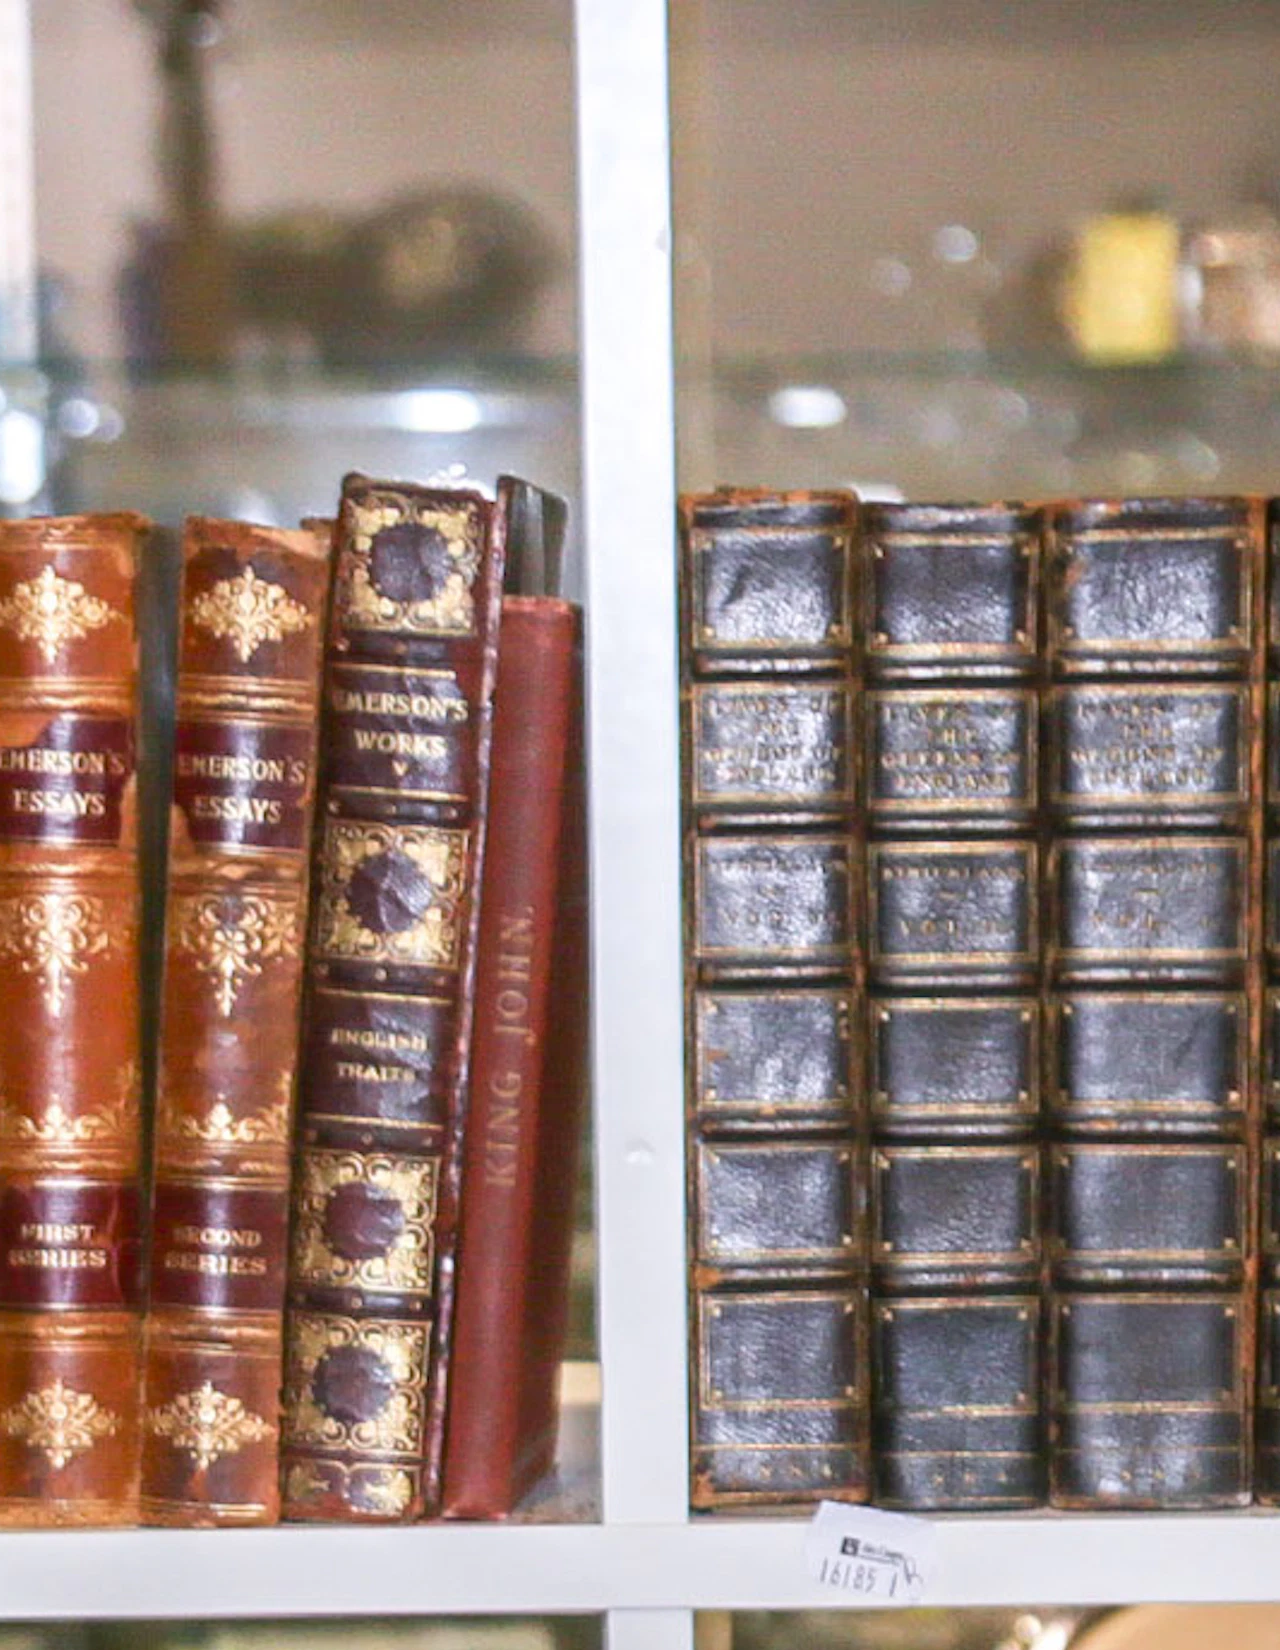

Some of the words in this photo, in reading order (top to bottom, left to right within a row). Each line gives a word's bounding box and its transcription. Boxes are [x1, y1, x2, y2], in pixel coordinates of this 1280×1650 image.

[331, 689, 470, 722] EMERSON'S
[352, 729, 449, 759] WORKS
[179, 754, 307, 784] EMERSON'S
[14, 789, 107, 816] ESSAYS
[194, 796, 282, 824] ESSAYS
[331, 1027, 428, 1052] ENGLISH
[337, 1061, 417, 1084] TRAITS
[485, 1070, 523, 1187] KING
[21, 1224, 95, 1244] FIRST
[173, 1226, 263, 1248] SECOND
[8, 1248, 107, 1269] SERIES
[164, 1253, 268, 1275] SERIES
